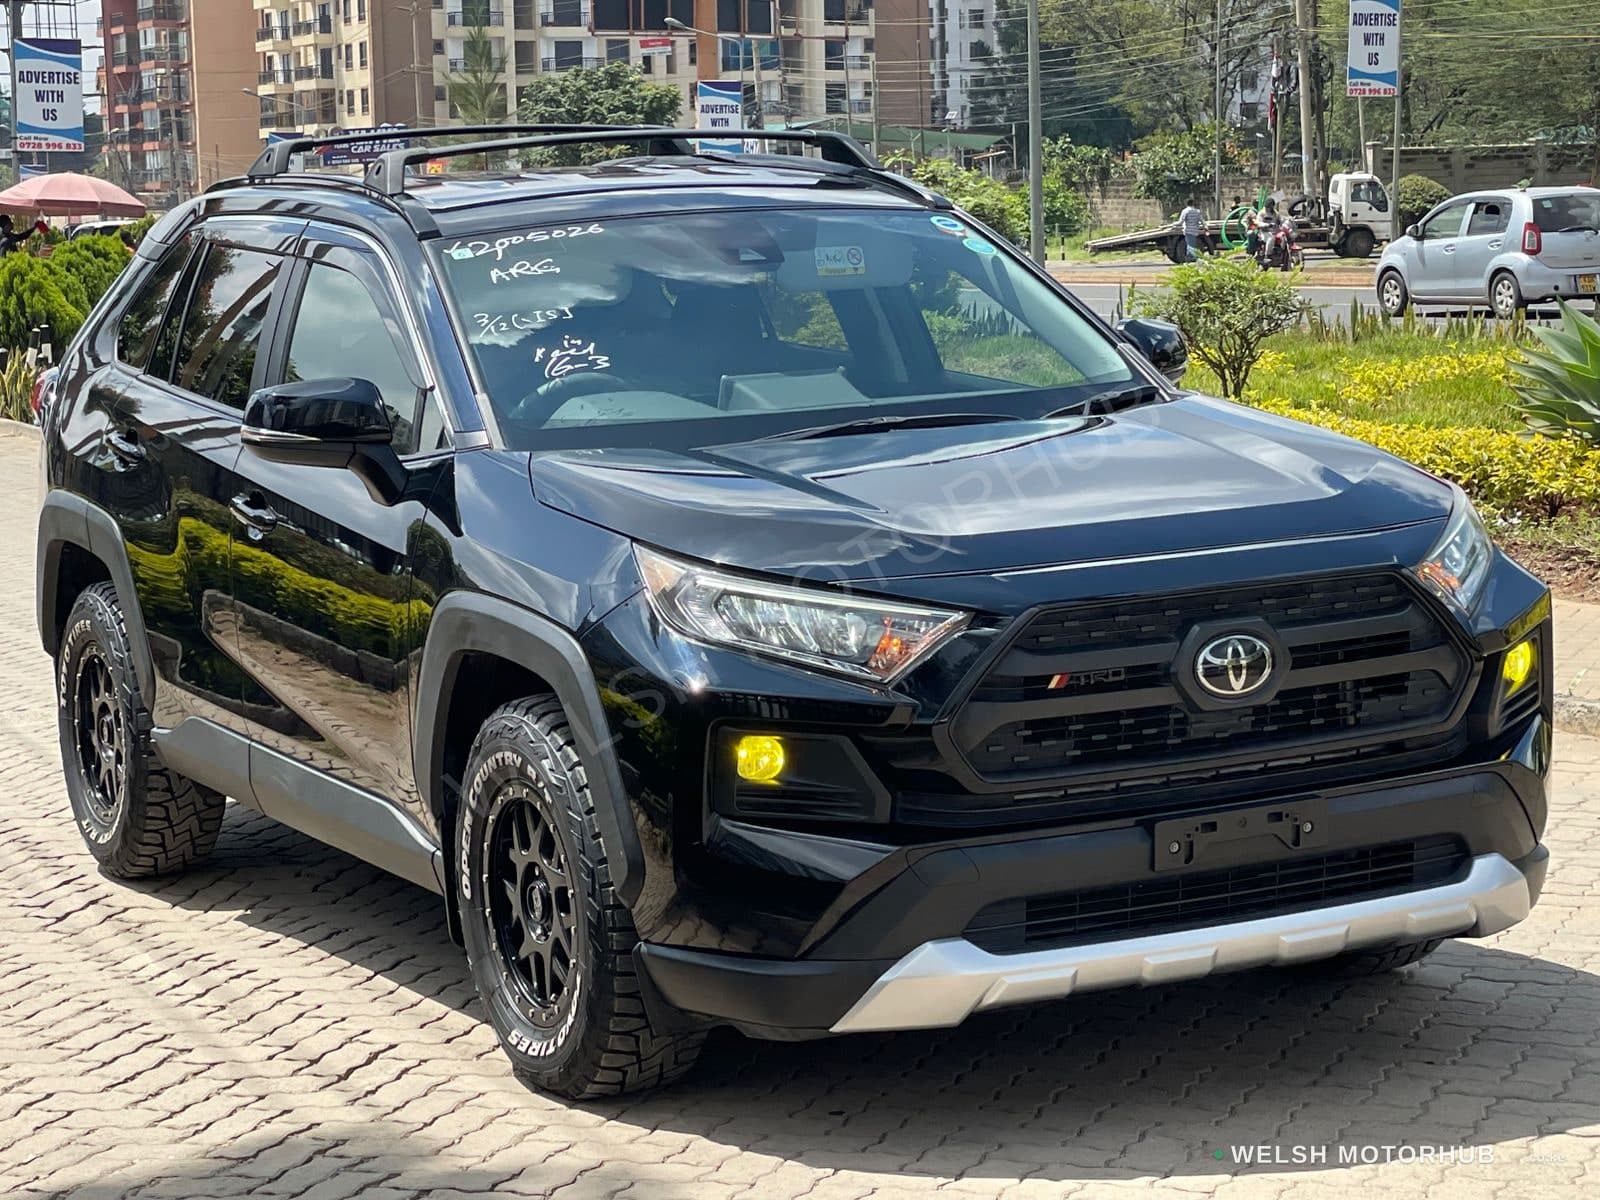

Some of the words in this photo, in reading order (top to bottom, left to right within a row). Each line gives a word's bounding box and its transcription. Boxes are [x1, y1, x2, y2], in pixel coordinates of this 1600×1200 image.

[1352, 12, 1397, 27] ADVERTISE
[1363, 32, 1385, 47] WITH
[1367, 52, 1379, 66] US
[18, 70, 80, 85] ADVERTISE
[34, 89, 64, 104] WITH
[42, 108, 58, 121] US
[700, 104, 739, 114] ADVERTISE
[710, 118, 730, 128] WITH
[19, 142, 43, 150] 0728
[45, 142, 63, 150] 996
[351, 145, 372, 153] CAR
[373, 142, 406, 152] SALES
[67, 619, 92, 647] TIRES
[461, 806, 474, 900] OPEN
[468, 751, 523, 810] COUNTRY
[507, 1027, 559, 1057] TIRES
